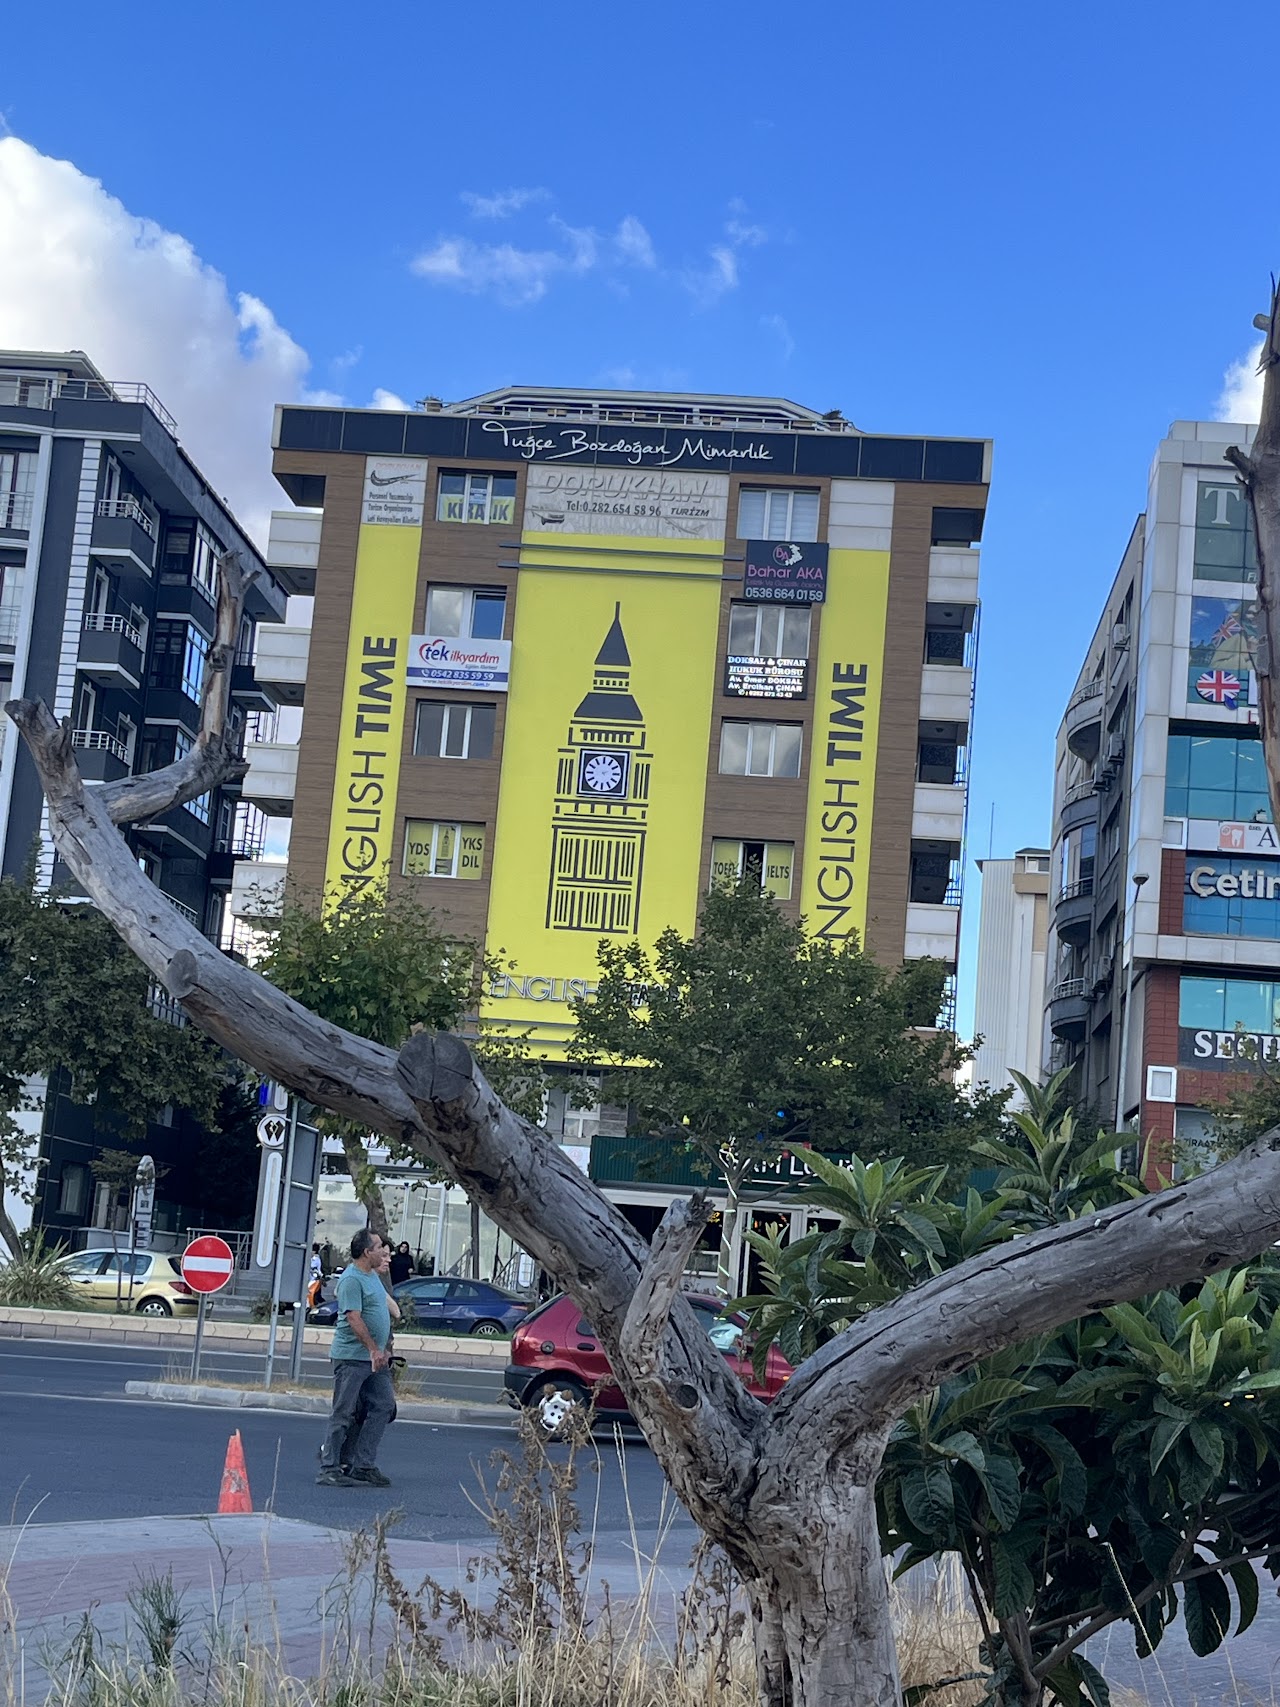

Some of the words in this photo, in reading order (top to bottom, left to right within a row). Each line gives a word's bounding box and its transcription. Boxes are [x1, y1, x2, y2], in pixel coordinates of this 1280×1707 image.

[482, 420, 556, 458] Tuğçe
[545, 430, 671, 464] Bozdoğan
[655, 438, 773, 466] Mimarlık
[634, 504, 646, 516] 58
[649, 505, 661, 517] 96
[670, 506, 710, 517] TURİZM
[747, 564, 792, 579] Bahar
[796, 566, 824, 580] AKA
[745, 587, 773, 599] 0536
[774, 588, 795, 600] 664
[796, 589, 824, 601] 0159
[425, 645, 450, 661] tek
[449, 650, 500, 665] ilkyardım
[727, 656, 766, 665] DOKSAL
[777, 659, 807, 667] ÇINAR
[430, 669, 453, 678] 0542
[453, 671, 470, 679] 835
[470, 672, 482, 680] 59
[483, 672, 495, 681] 59
[729, 666, 763, 674] HUKUK
[764, 666, 804, 676] BÜROSU
[354, 636, 398, 738] TIME
[768, 677, 803, 685] DOKSAL
[826, 663, 868, 767] TIME
[336, 750, 387, 910] NGLISH
[409, 842, 430, 856] YDS
[462, 837, 483, 851] YKS
[814, 779, 860, 940] NGLISH
[766, 865, 790, 879] IELTS
[489, 973, 600, 1003] ENGLISH
